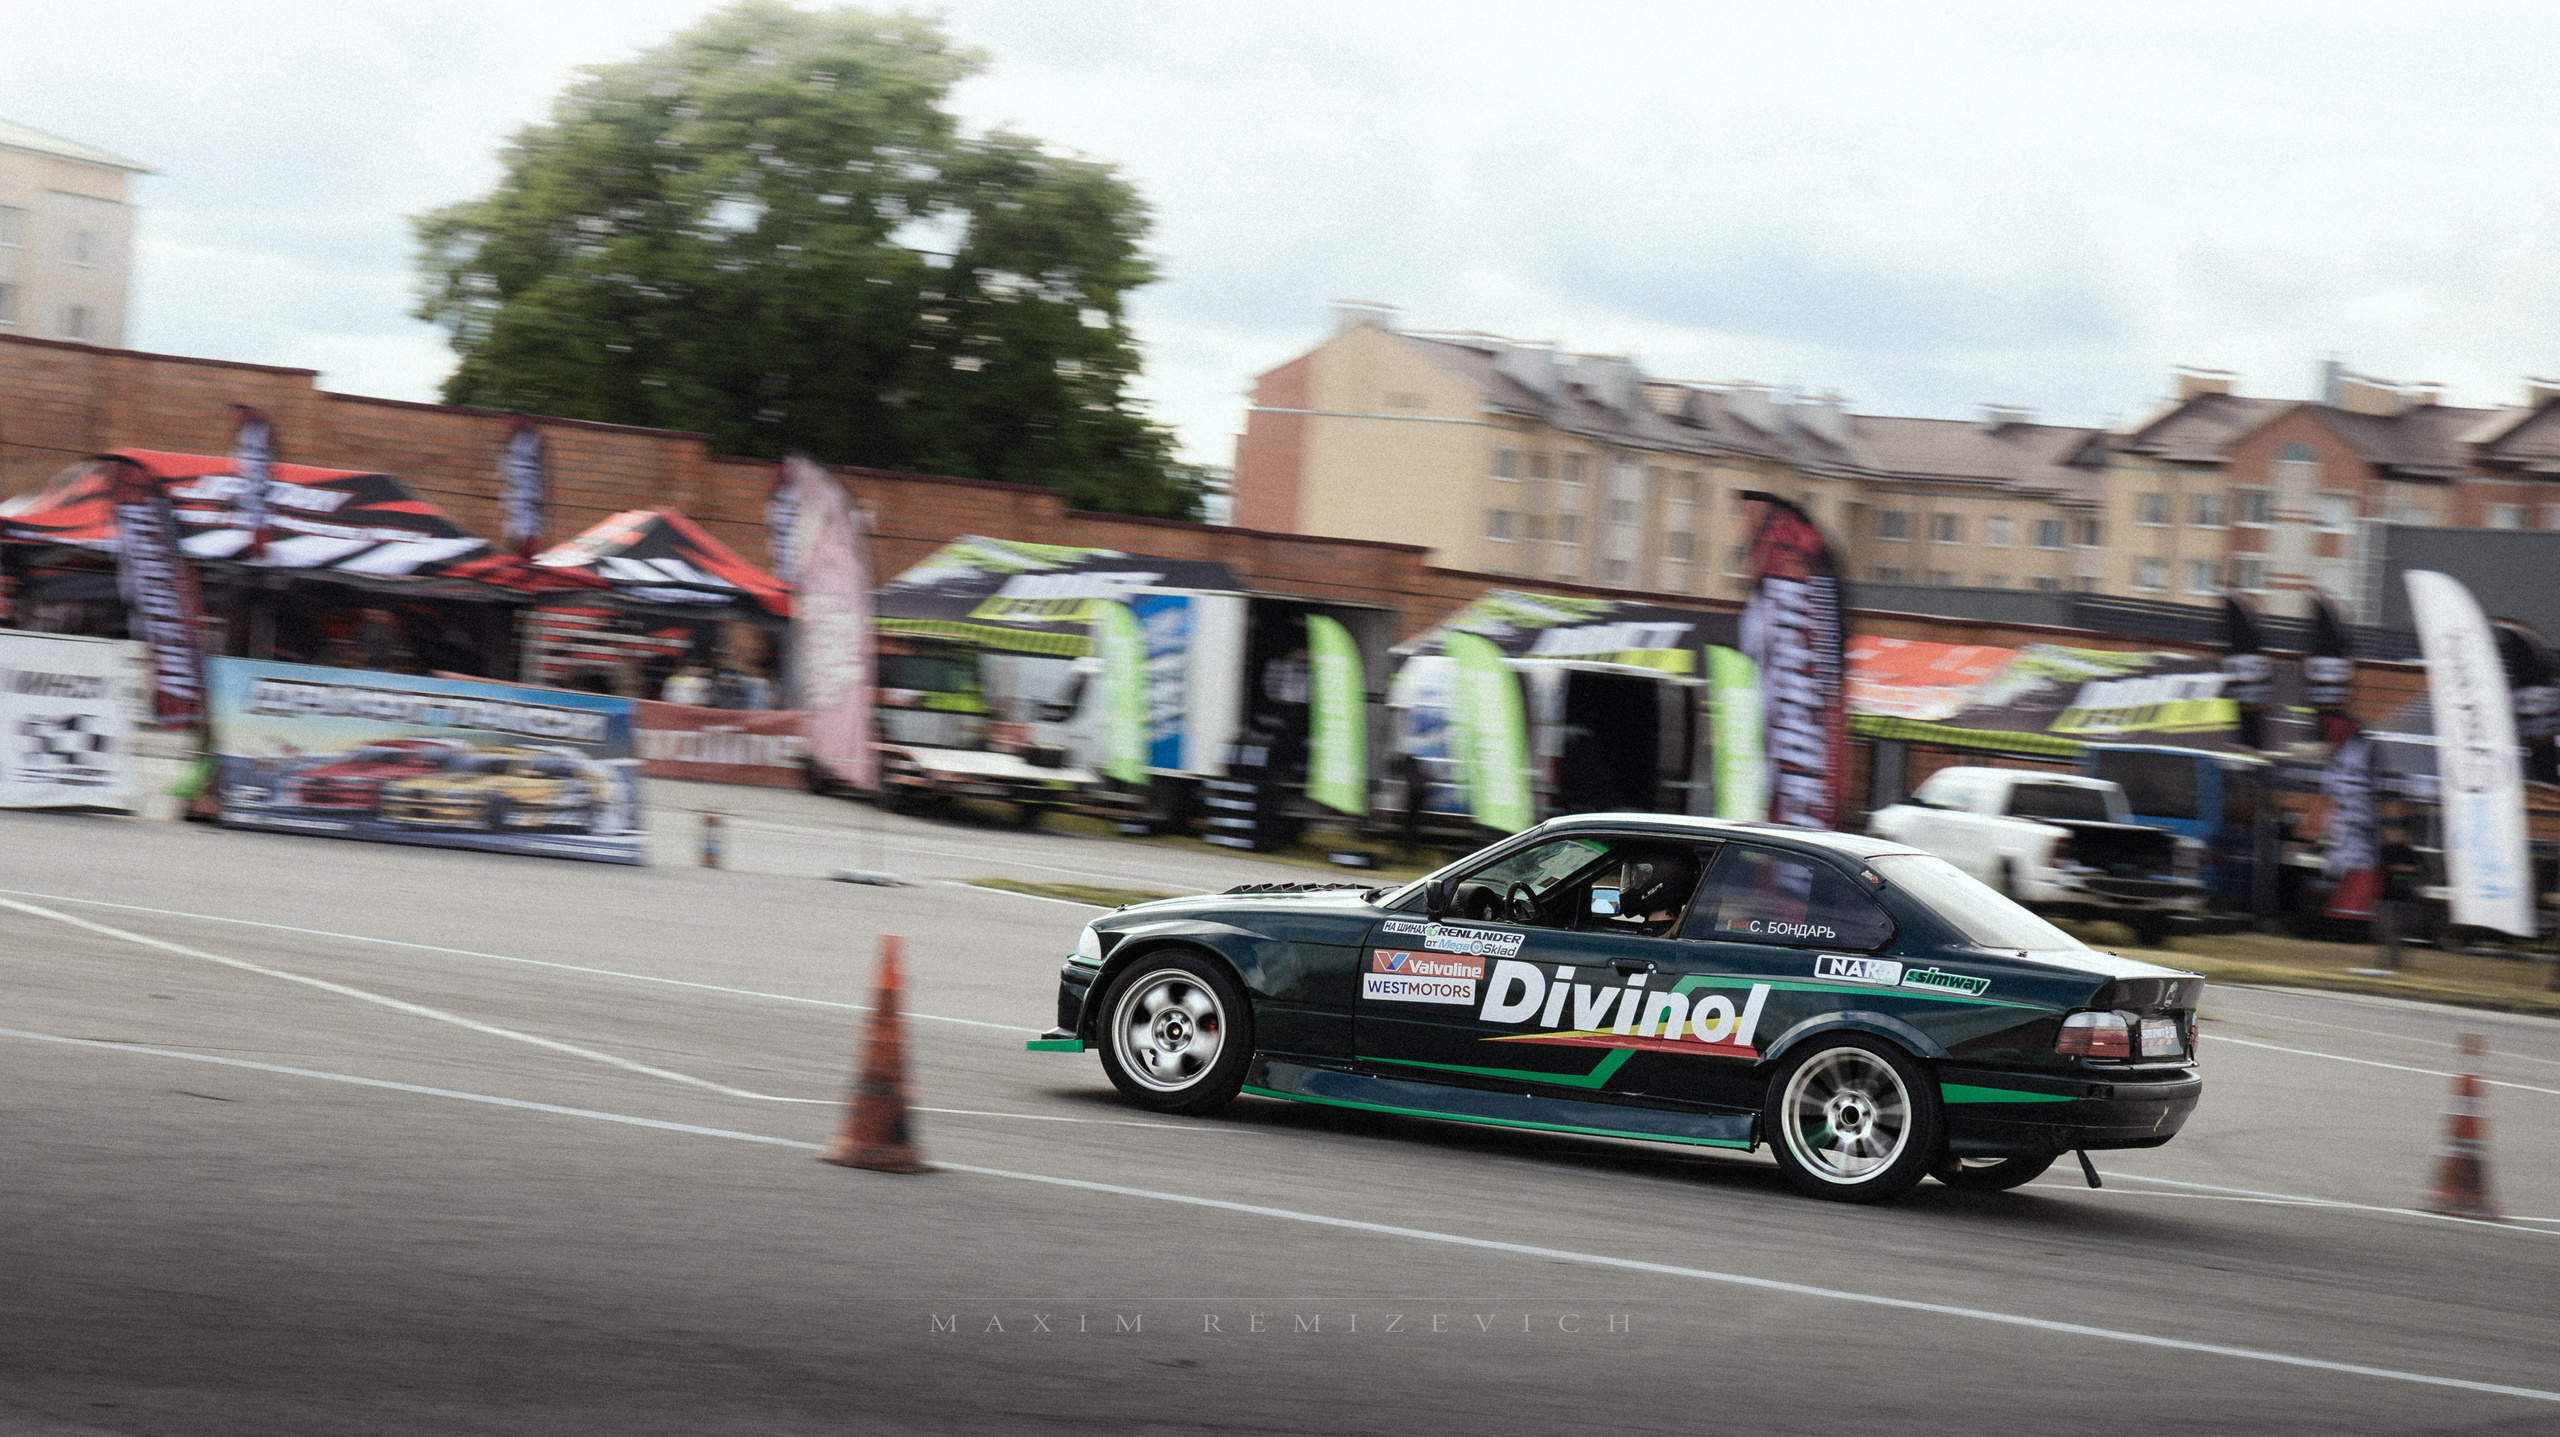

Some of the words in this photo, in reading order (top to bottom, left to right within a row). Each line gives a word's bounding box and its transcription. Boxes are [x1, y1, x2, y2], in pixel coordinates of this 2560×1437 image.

[1384, 921, 1396, 931] НА
[1397, 922, 1427, 934] ШИНАХ
[1749, 920, 1763, 933] С.
[1767, 921, 1836, 939] БОНДАРЬ
[1409, 959, 1482, 978] Valvoline
[1367, 980, 1471, 998] WESTMOTORS
[1479, 959, 1772, 1047] Divinol
